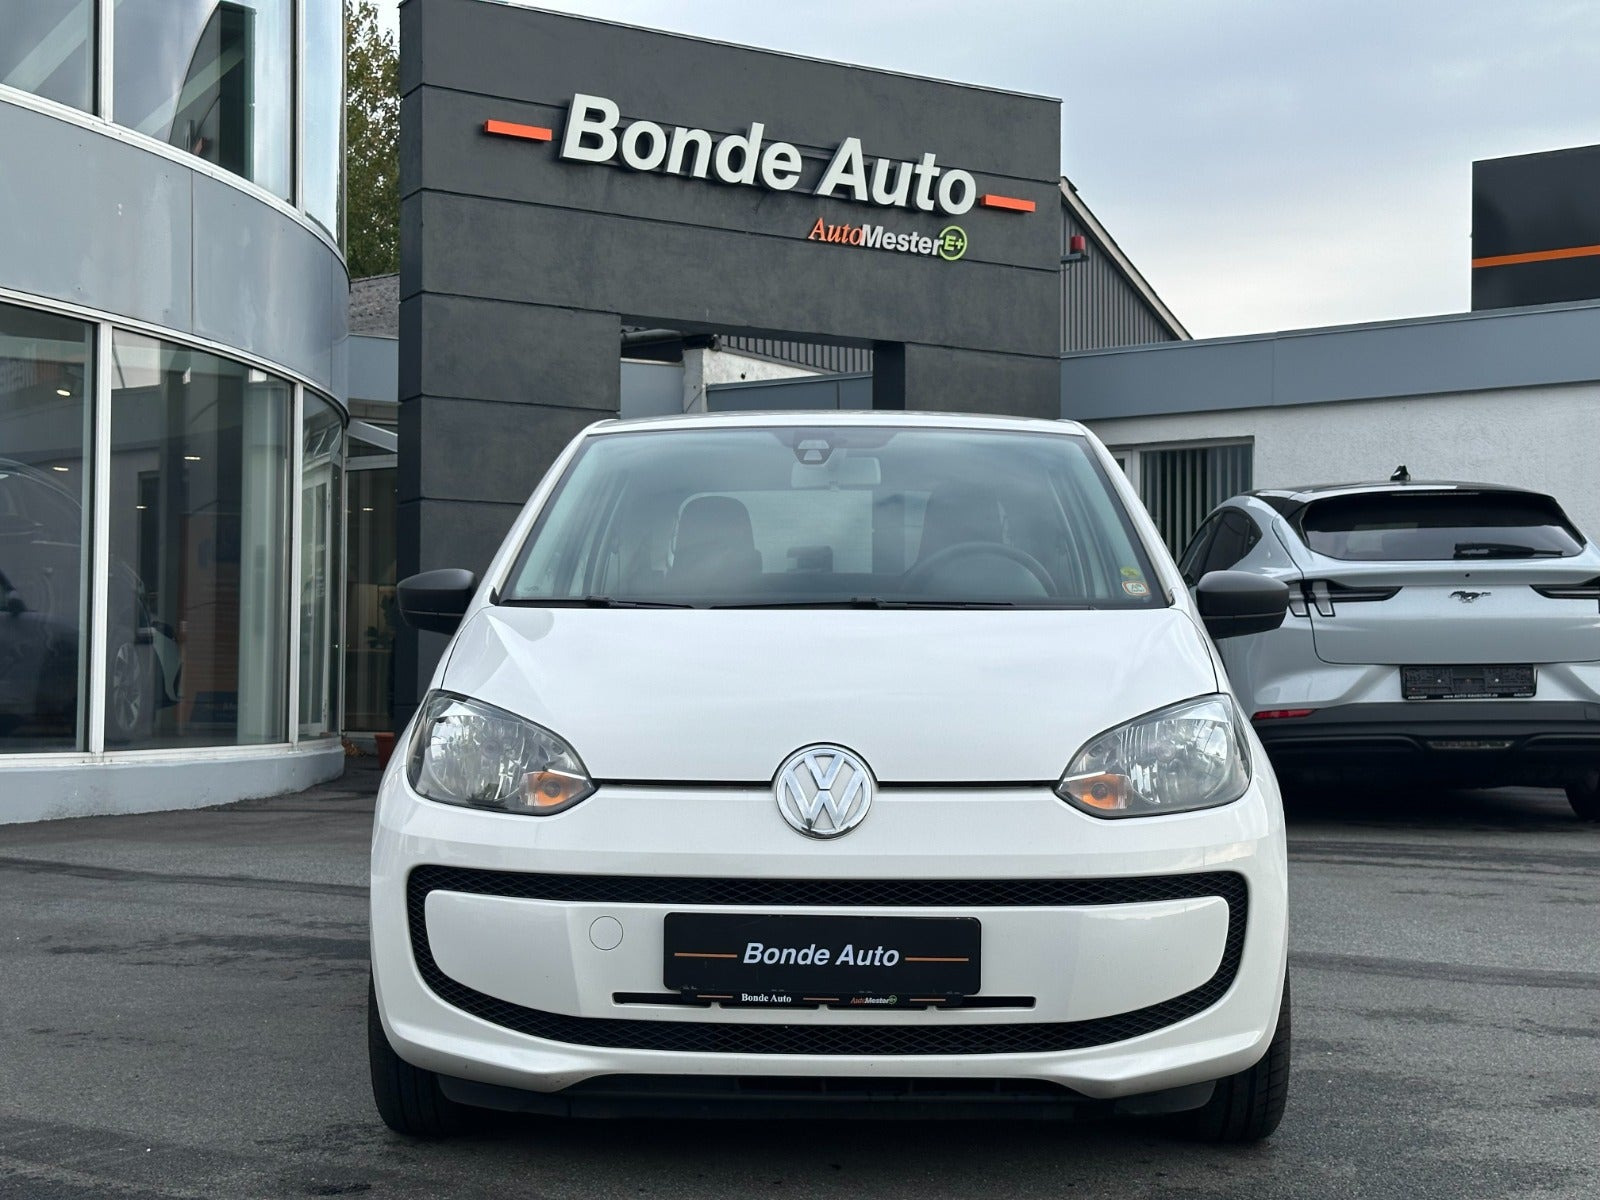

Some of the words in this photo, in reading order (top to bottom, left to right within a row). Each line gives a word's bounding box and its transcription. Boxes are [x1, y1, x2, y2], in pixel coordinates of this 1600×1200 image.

[561, 93, 802, 191] Bonde
[814, 136, 978, 215] Auto
[808, 217, 944, 256] AutoMester
[742, 942, 830, 966] Bonde
[835, 944, 900, 967] Auto
[741, 993, 769, 1003] Bonde
[770, 994, 792, 1003] Auto
